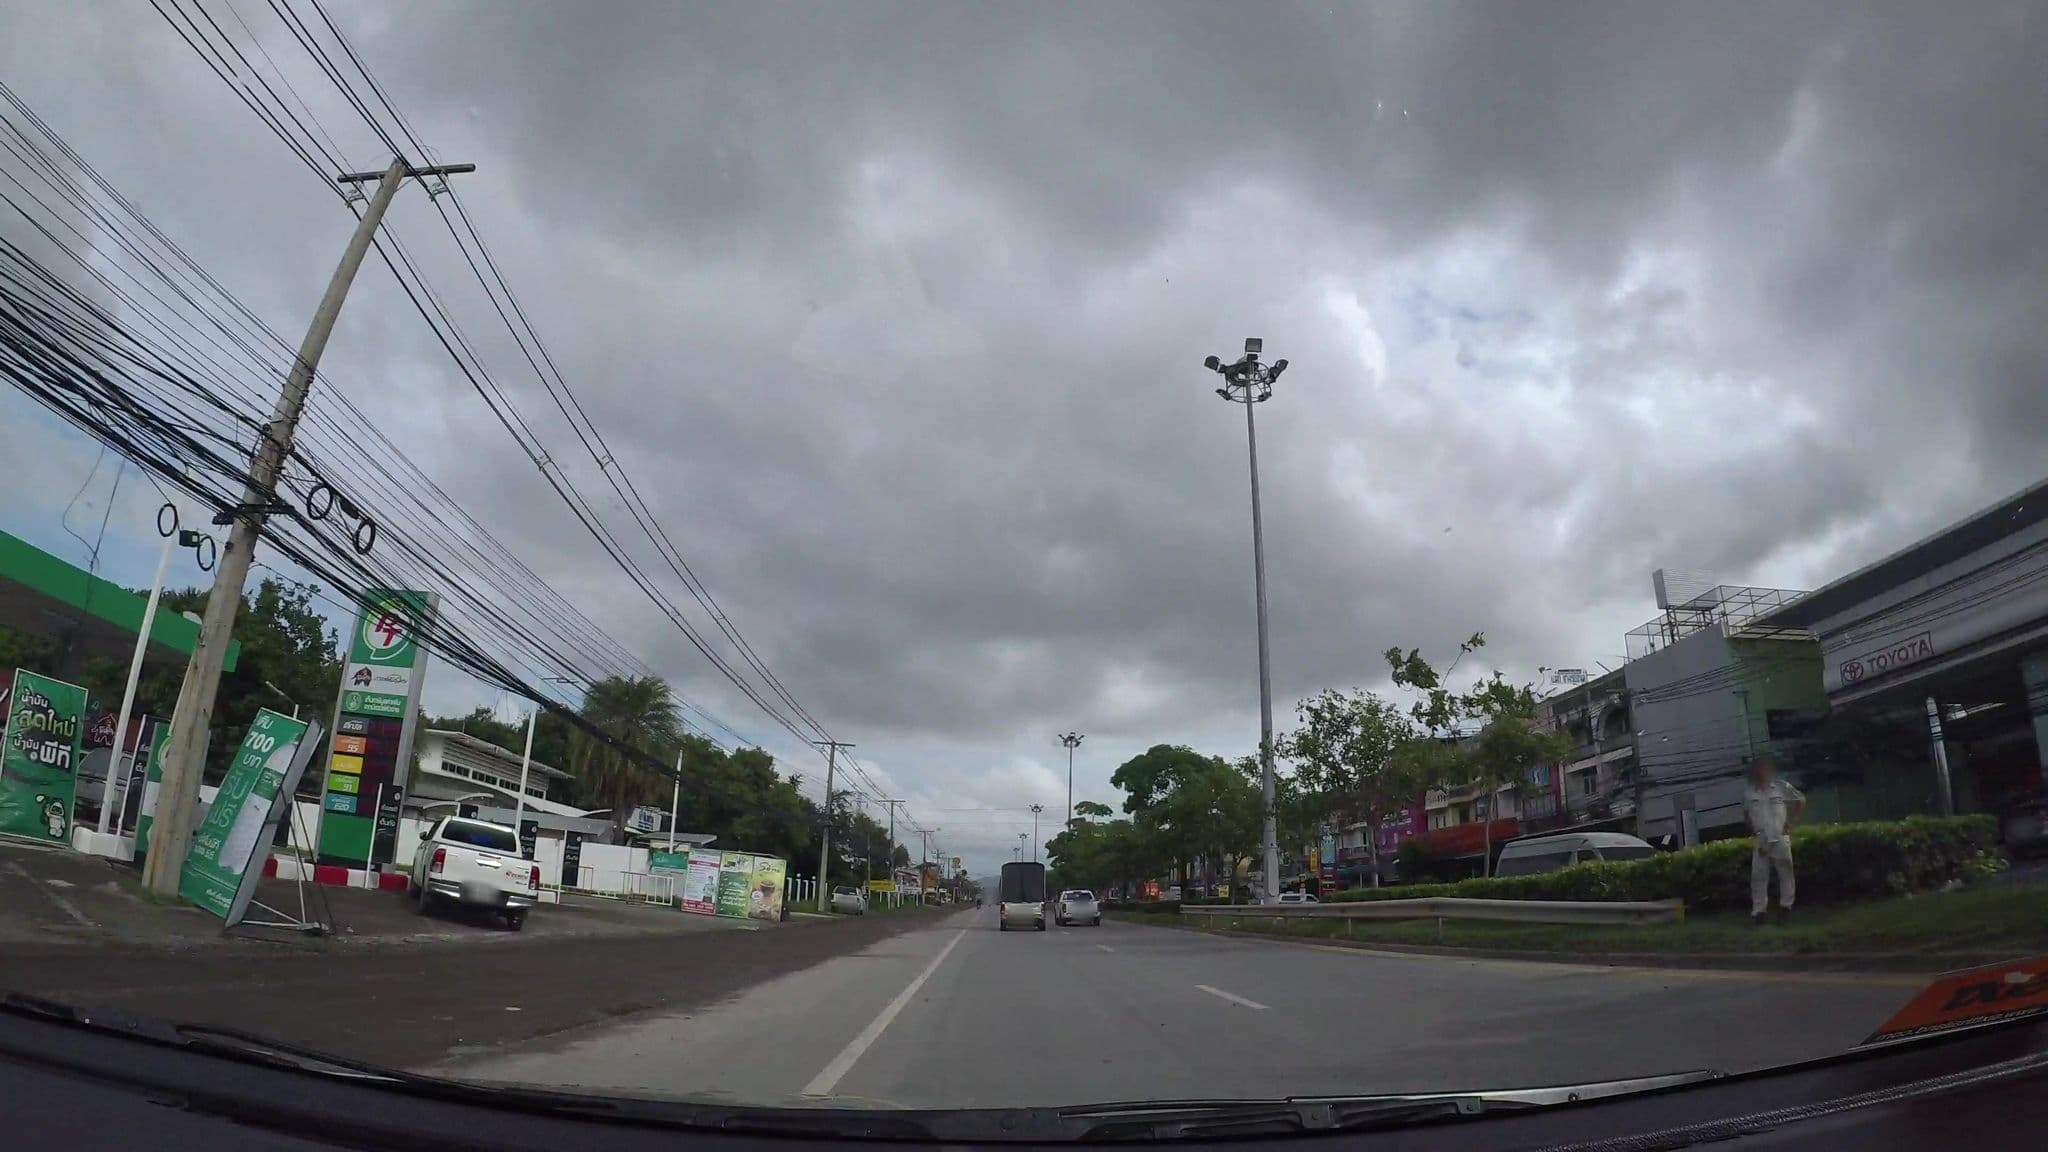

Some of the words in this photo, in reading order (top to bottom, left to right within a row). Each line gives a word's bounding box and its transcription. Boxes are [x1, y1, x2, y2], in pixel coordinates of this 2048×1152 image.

[1868, 639, 1930, 673] TOYOTA
[21, 686, 49, 707] น้ำมัน
[18, 709, 76, 737] สดใหม่
[14, 734, 40, 751] น้ำมัน
[40, 740, 72, 769] พีที
[245, 730, 275, 753] 700
[242, 752, 262, 769] บาท
